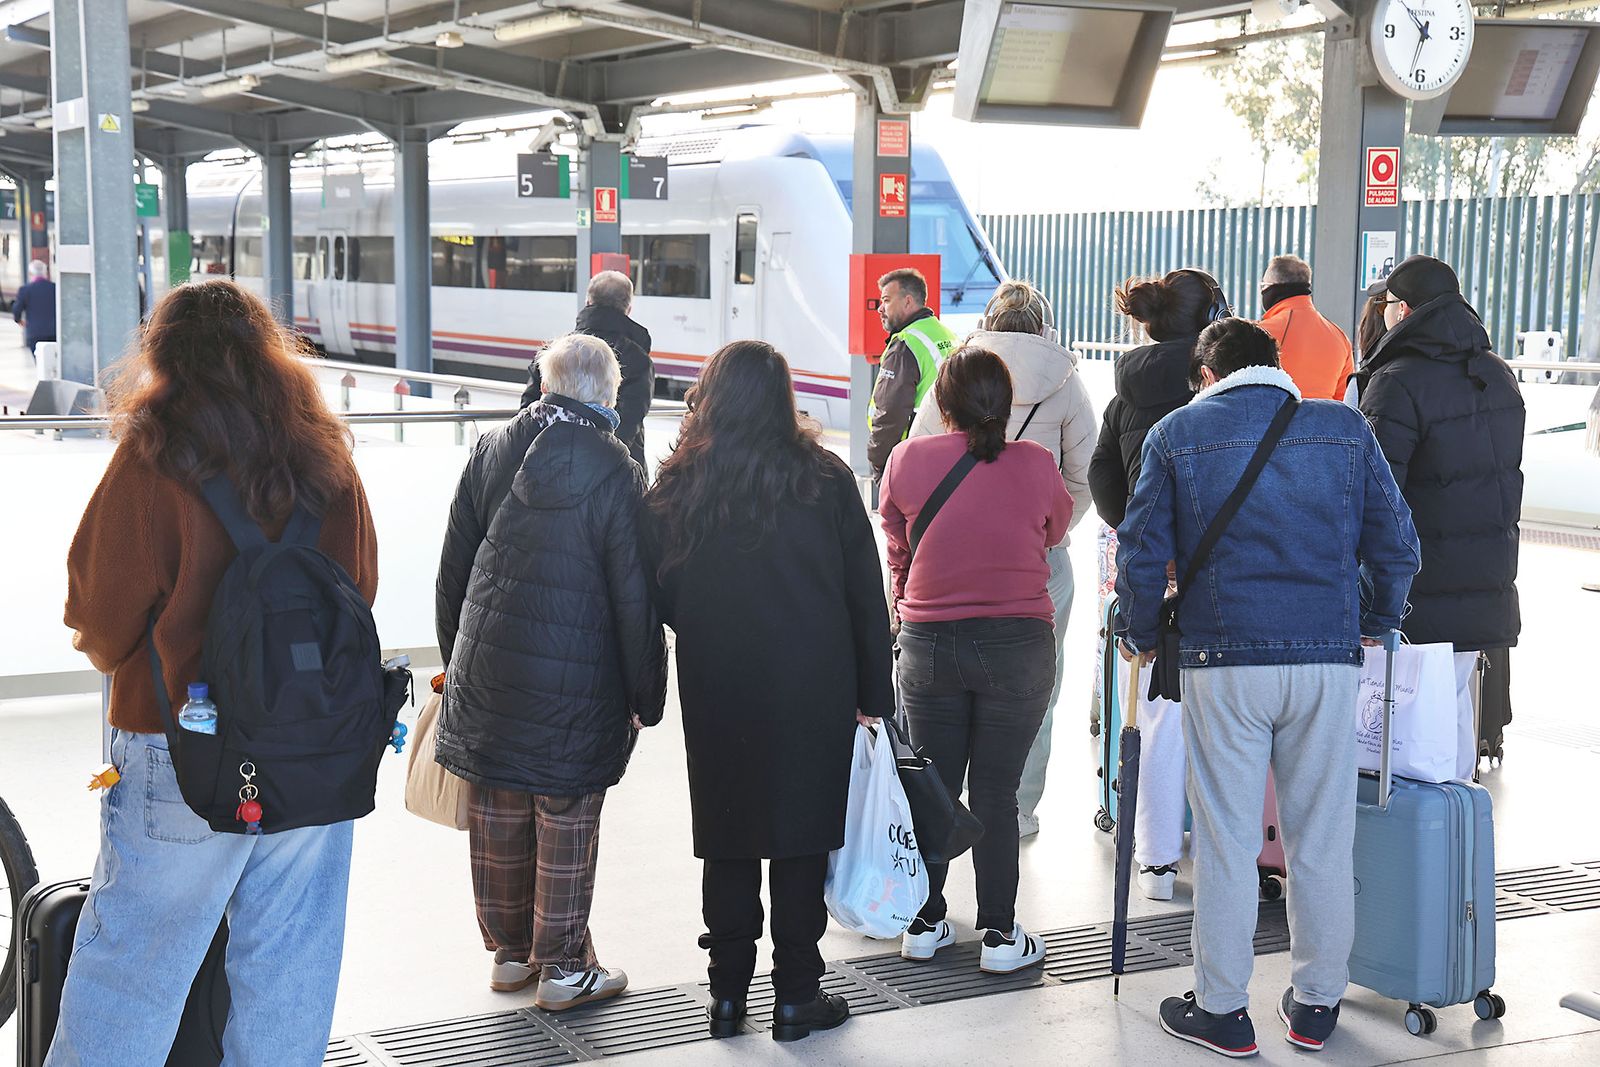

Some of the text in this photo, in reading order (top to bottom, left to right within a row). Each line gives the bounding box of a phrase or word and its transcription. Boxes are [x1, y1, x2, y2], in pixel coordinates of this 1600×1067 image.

[1384, 24, 1396, 39] 9
[1449, 26, 1460, 40] 3
[1414, 68, 1426, 83] 6
[521, 173, 534, 196] 5
[652, 177, 665, 198] 7
[5, 202, 15, 218] 7
